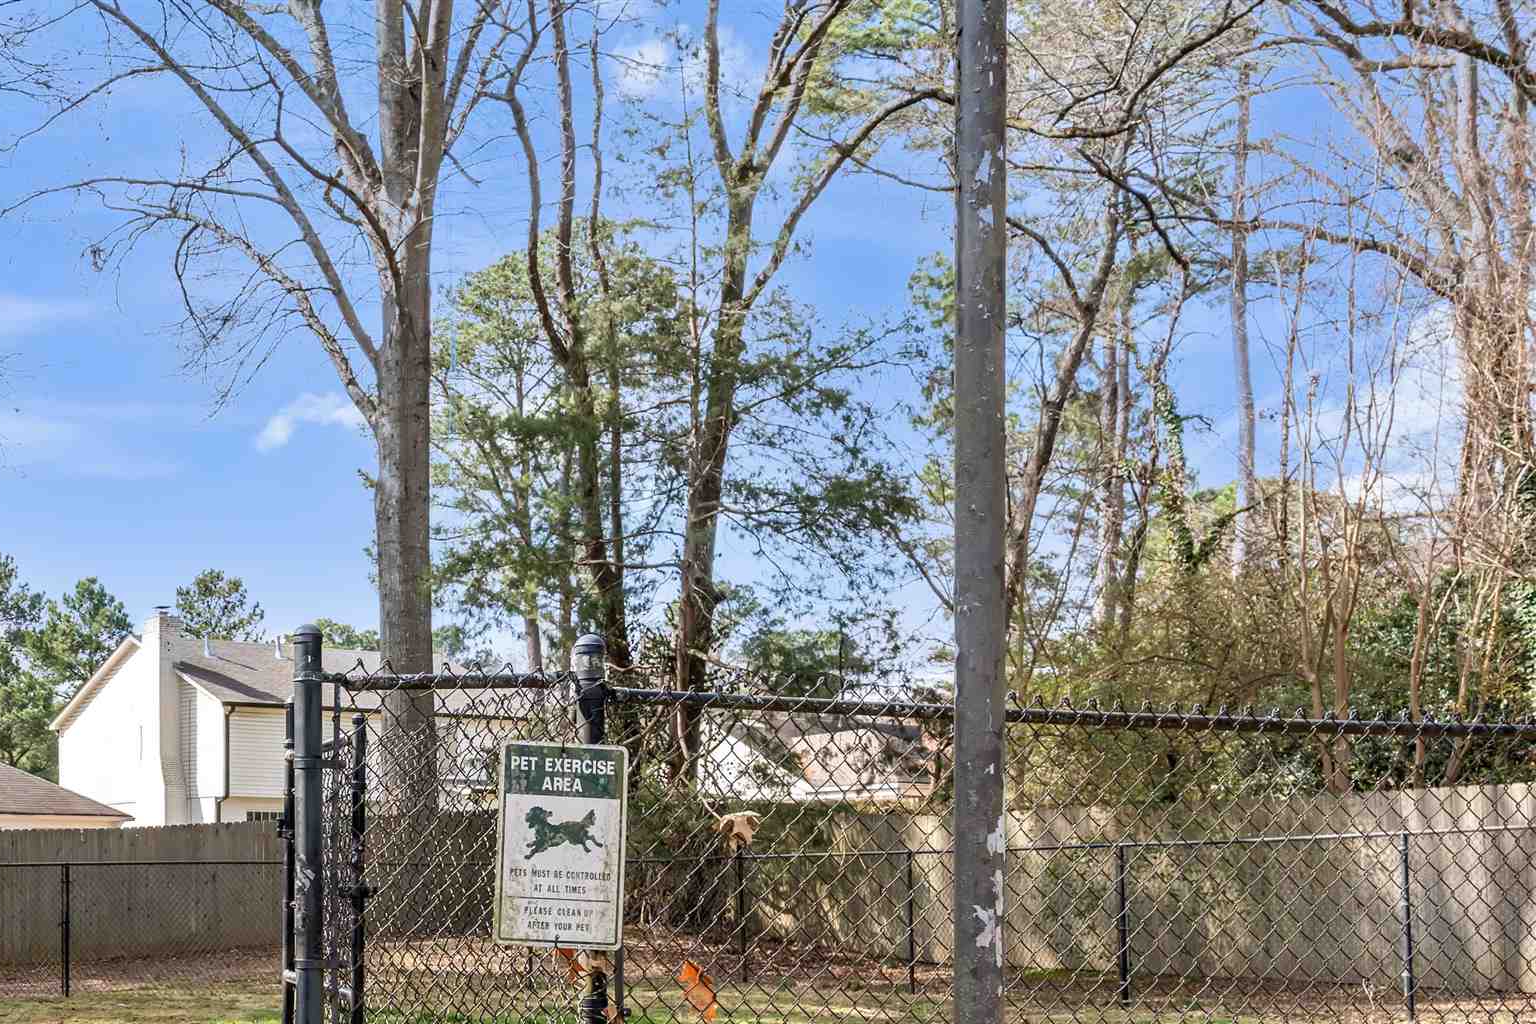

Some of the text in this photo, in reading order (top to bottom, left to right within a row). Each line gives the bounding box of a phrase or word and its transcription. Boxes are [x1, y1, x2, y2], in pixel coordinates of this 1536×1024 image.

[510, 755, 616, 776] PET EXERCISE
[541, 776, 583, 793] AREA
[509, 867, 612, 881] PETS MUST BE CONTROLLED
[533, 884, 587, 895] AT ALL TIMES
[524, 906, 553, 917] PLEASE
[556, 907, 581, 917] CLEAN
[527, 921, 591, 932] AFTER YOUR PET
